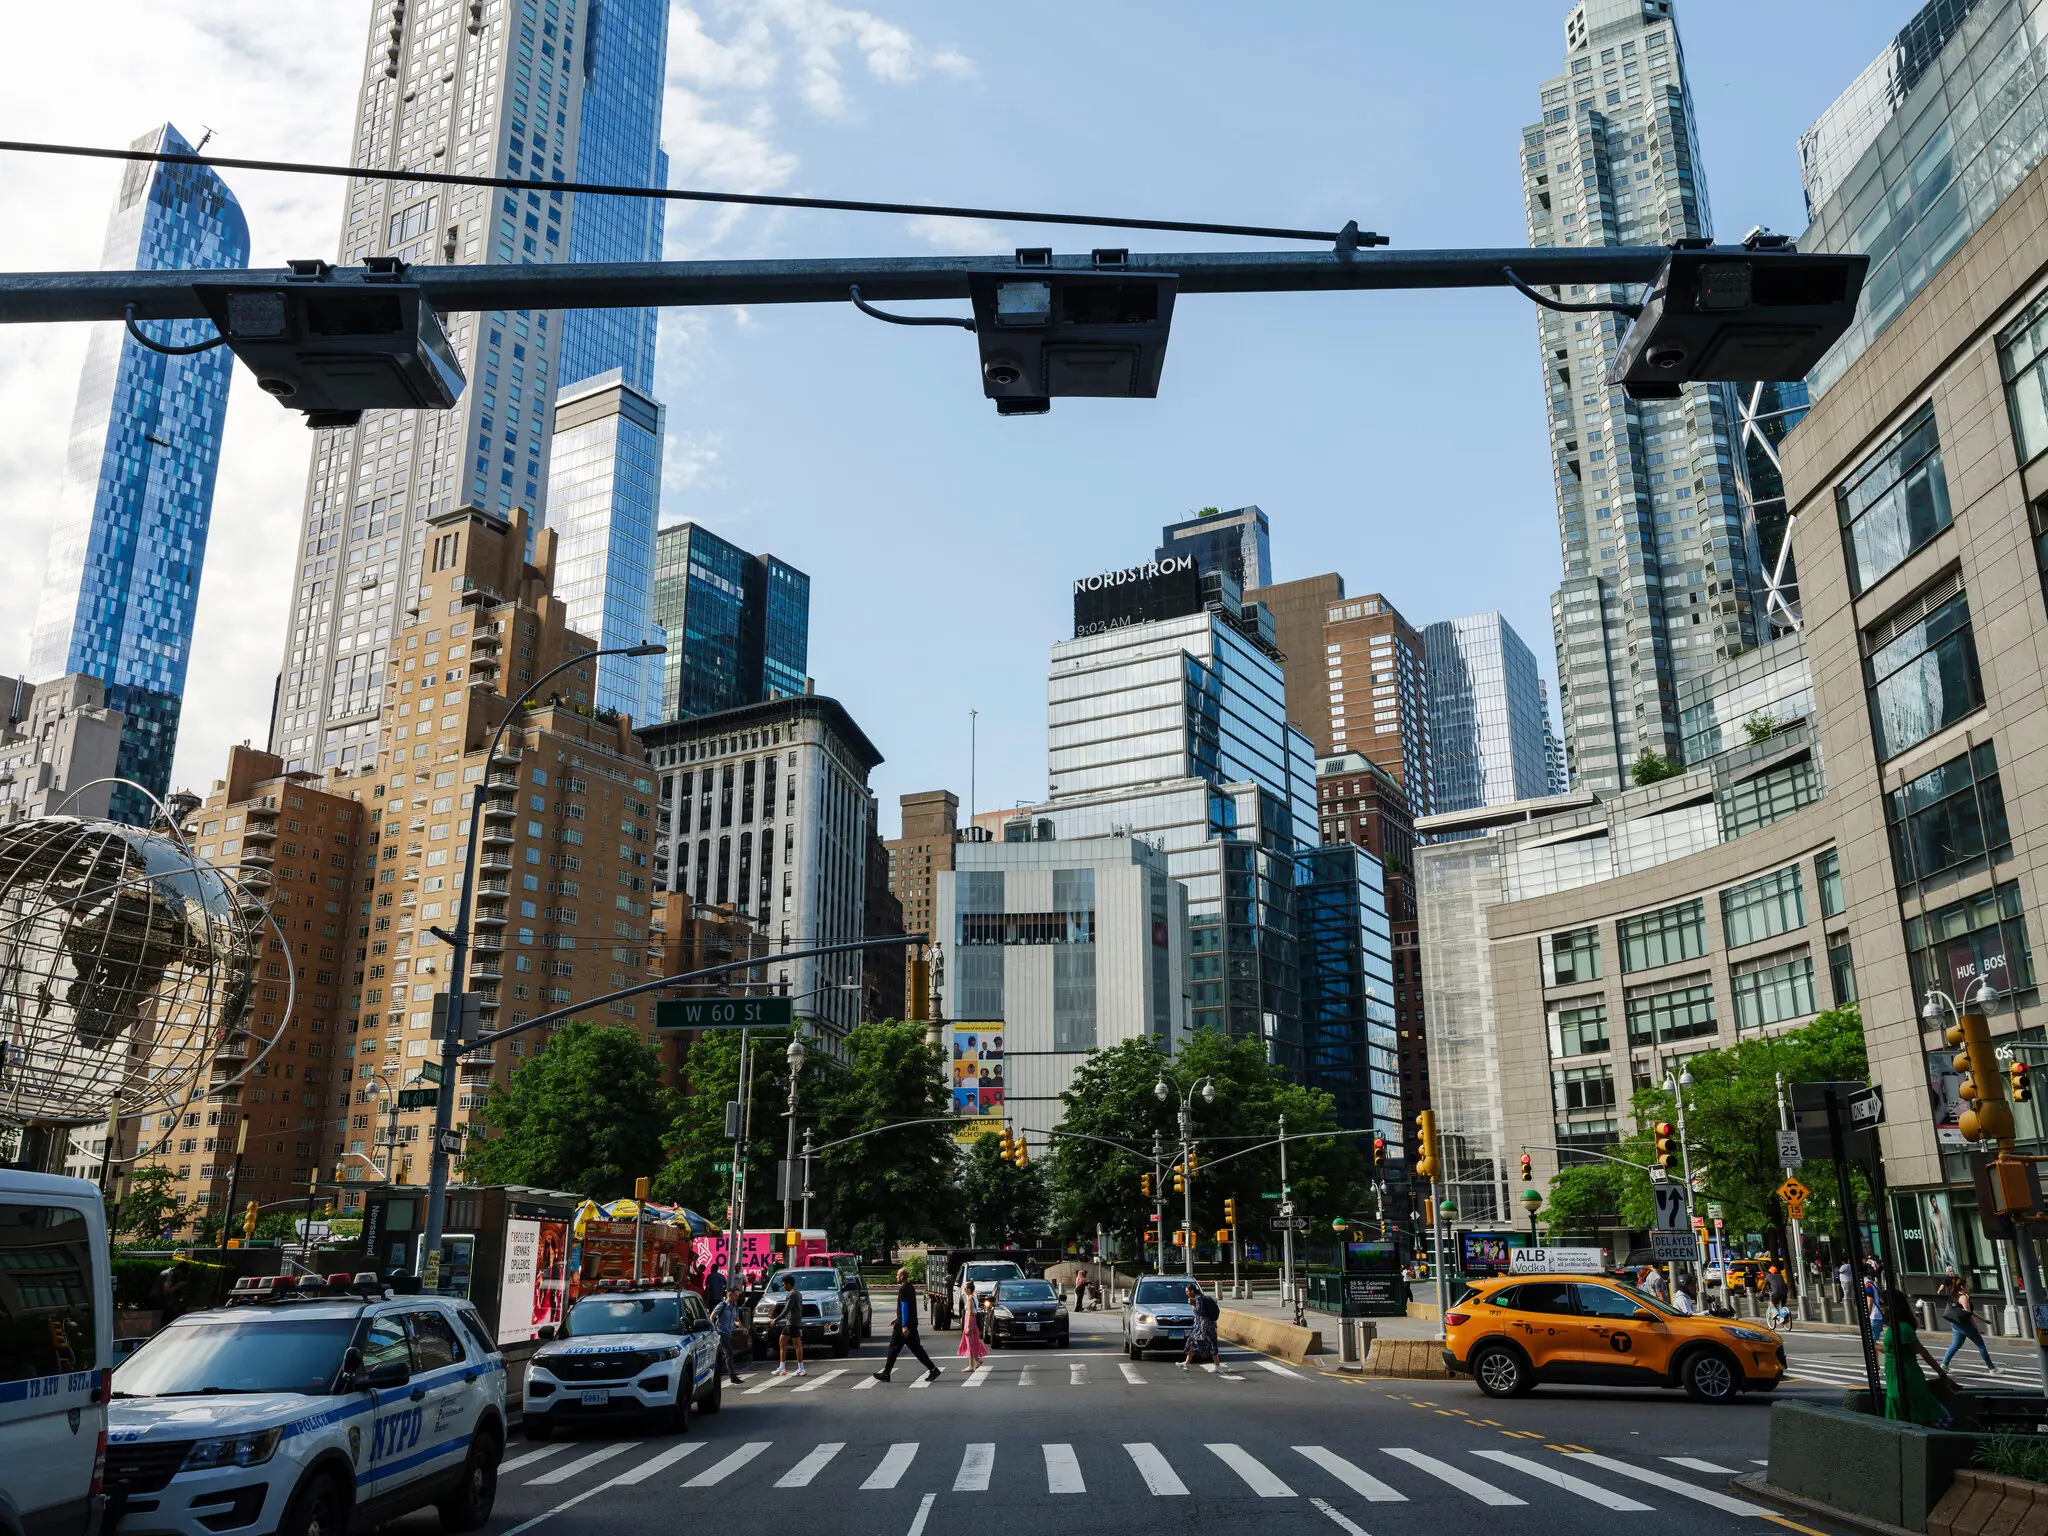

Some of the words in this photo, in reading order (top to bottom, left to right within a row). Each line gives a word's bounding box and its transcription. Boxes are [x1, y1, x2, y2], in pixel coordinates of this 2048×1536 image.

[1074, 554, 1192, 594] NORDSTROM
[1077, 621, 1105, 635] 9:02
[1110, 615, 1131, 628] AM
[686, 1005, 702, 1022] W
[712, 1004, 735, 1021] 60
[744, 1003, 762, 1020] St
[403, 1094, 409, 1105] W
[413, 1092, 423, 1105] 60
[1853, 1103, 1865, 1119] ONE
[1868, 1098, 1879, 1114] WAY
[1781, 1145, 1798, 1156] 25
[366, 1205, 380, 1256] Newsstand
[1903, 1229, 1923, 1240] BOSS
[716, 1238, 757, 1252] PICE
[1656, 1236, 1693, 1246] DELAYED
[1515, 1250, 1545, 1262] ALB
[1658, 1248, 1694, 1258] GREEN
[1516, 1263, 1546, 1272] Vodka
[597, 1345, 636, 1353] POLICE
[30, 1380, 40, 1398] TB
[298, 1413, 328, 1434] POLICE
[369, 1406, 423, 1462] NYPD
